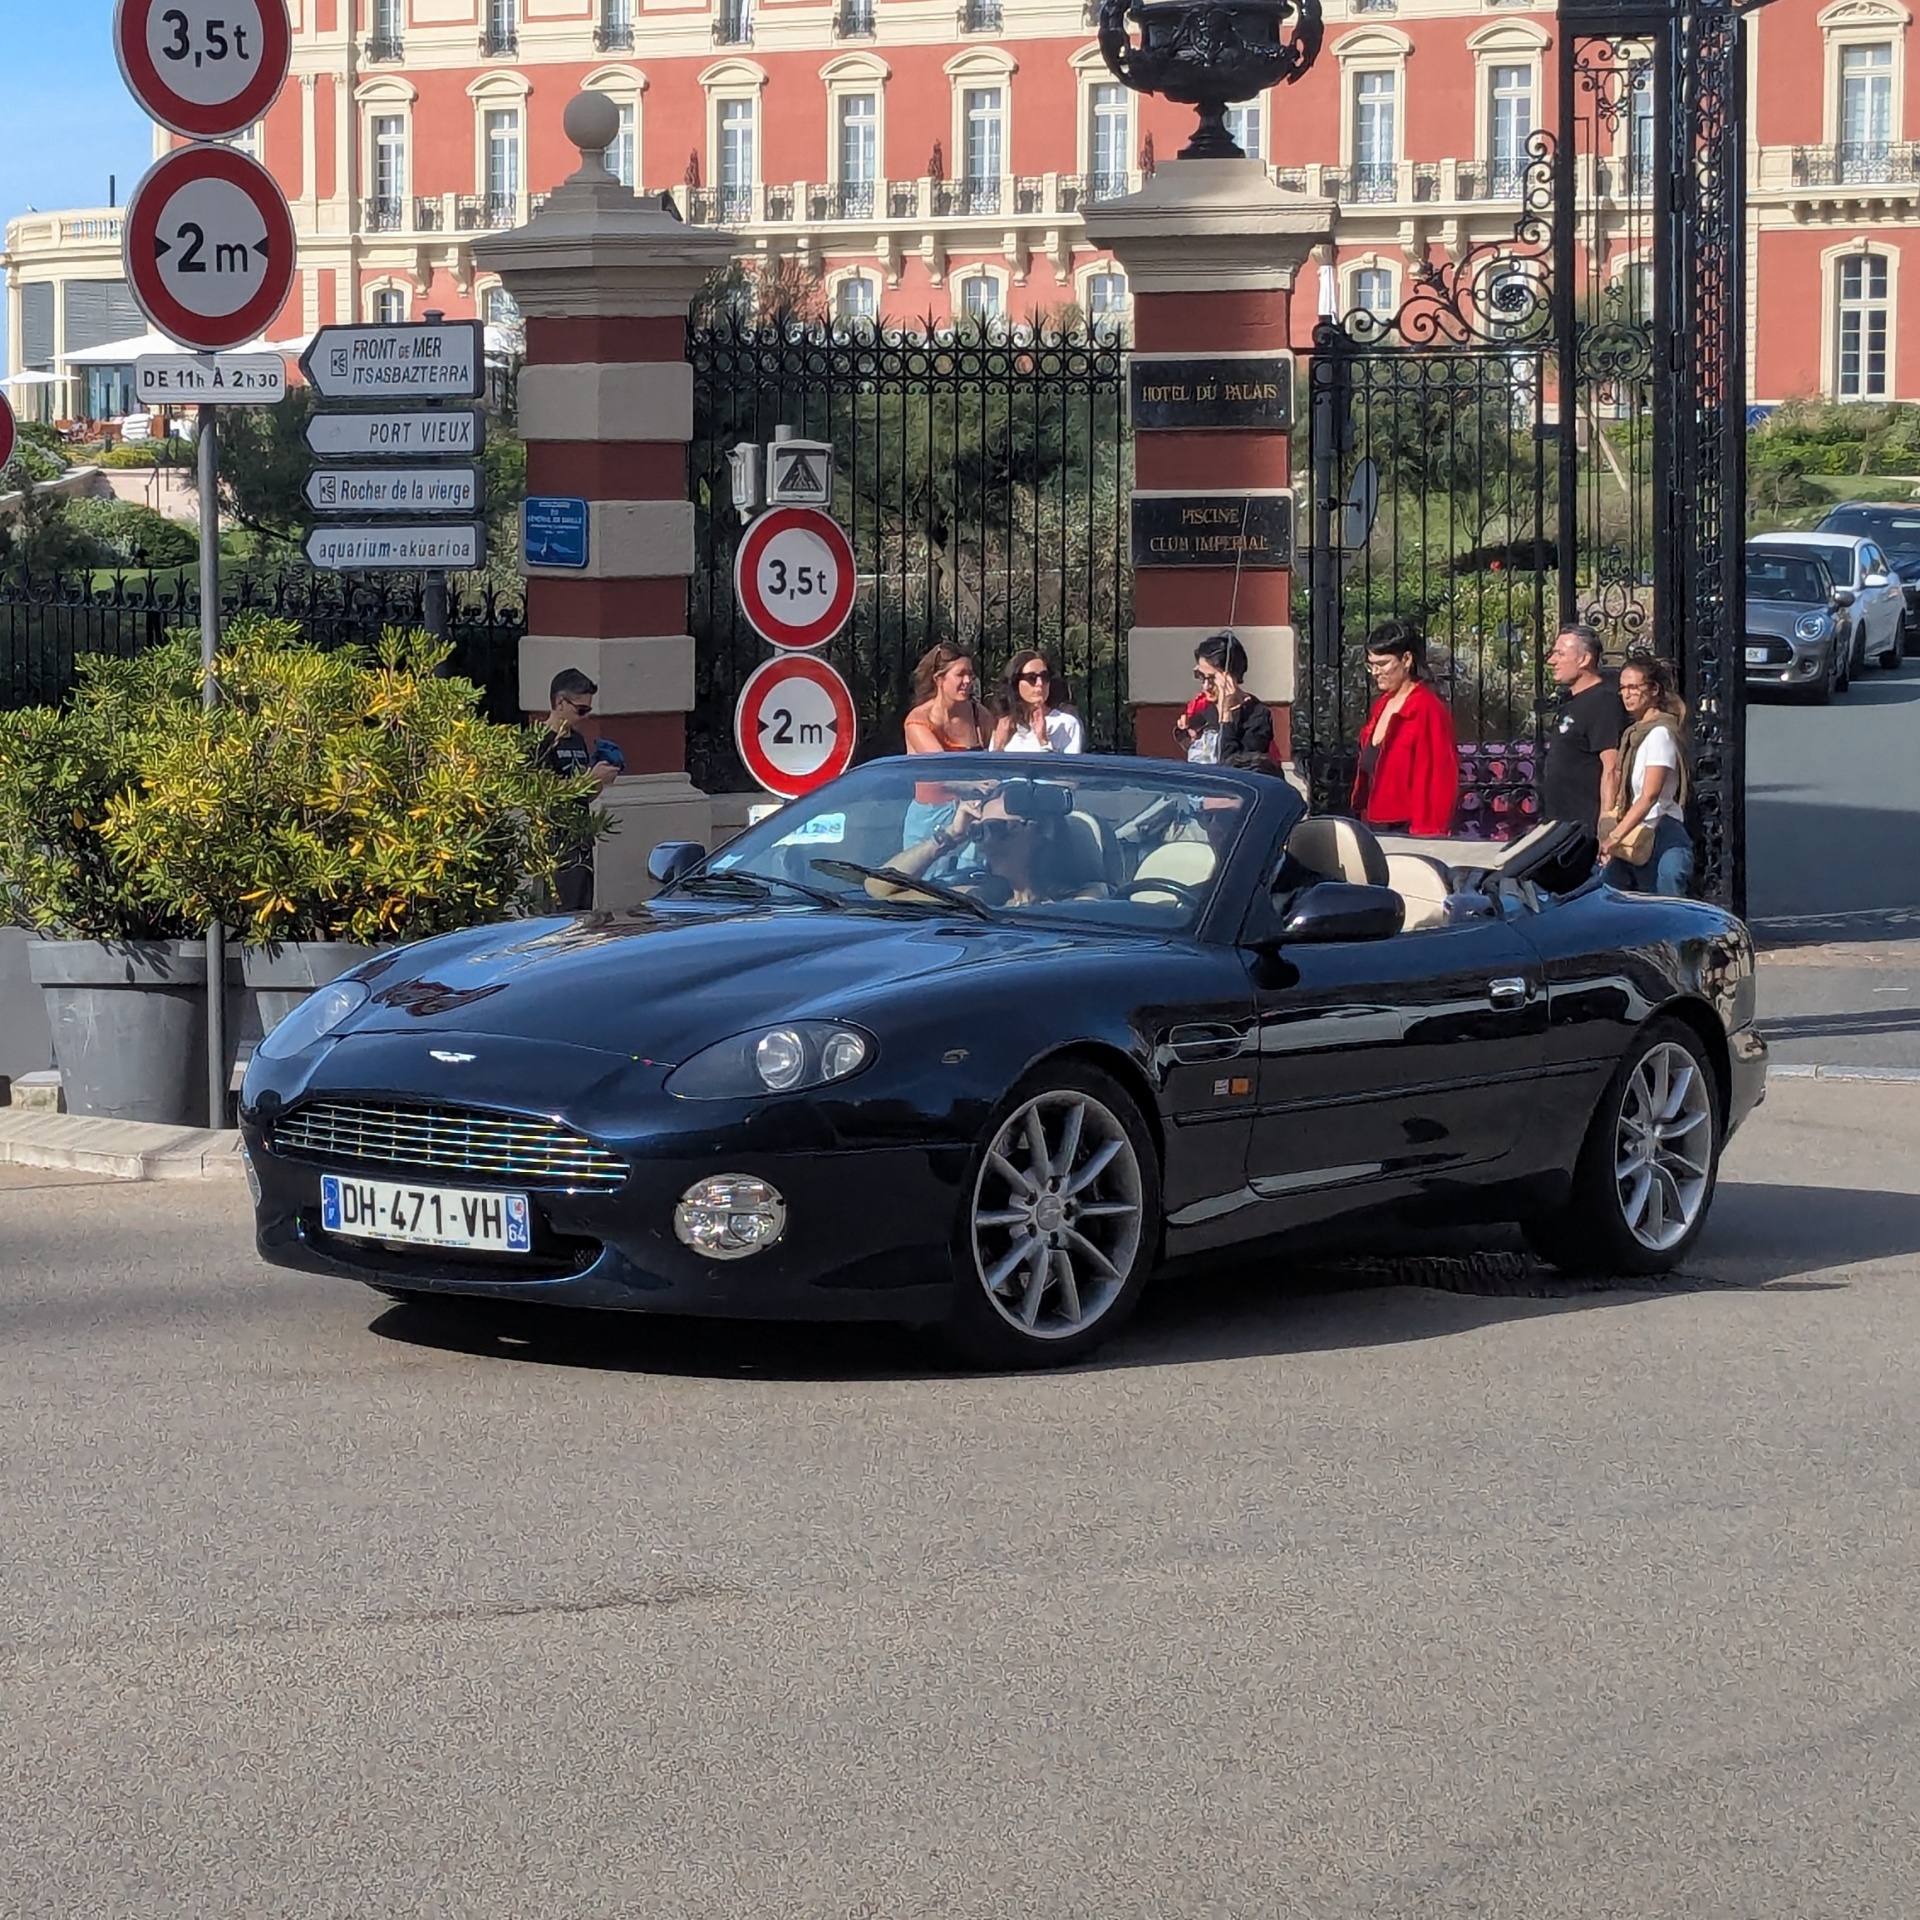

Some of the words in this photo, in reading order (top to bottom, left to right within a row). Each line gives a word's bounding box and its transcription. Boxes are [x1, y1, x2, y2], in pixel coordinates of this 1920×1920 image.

[162, 9, 250, 68] 3,5t
[352, 338, 397, 360] FRONT
[412, 336, 442, 358] MER
[143, 370, 169, 388] DE
[176, 369, 205, 388] 11h
[232, 370, 279, 388] 2h30
[352, 364, 469, 385] ITSASBAZTERRA
[1196, 384, 1218, 401] DU
[1224, 382, 1278, 401] PALAIS
[368, 422, 412, 444] PORT
[422, 421, 471, 443] VIEUX
[340, 479, 388, 501] Rocher
[391, 479, 408, 500] de
[411, 479, 424, 500] la
[428, 479, 471, 506] vierge
[1181, 507, 1240, 525] PISCINE
[767, 559, 828, 601] 3,5t
